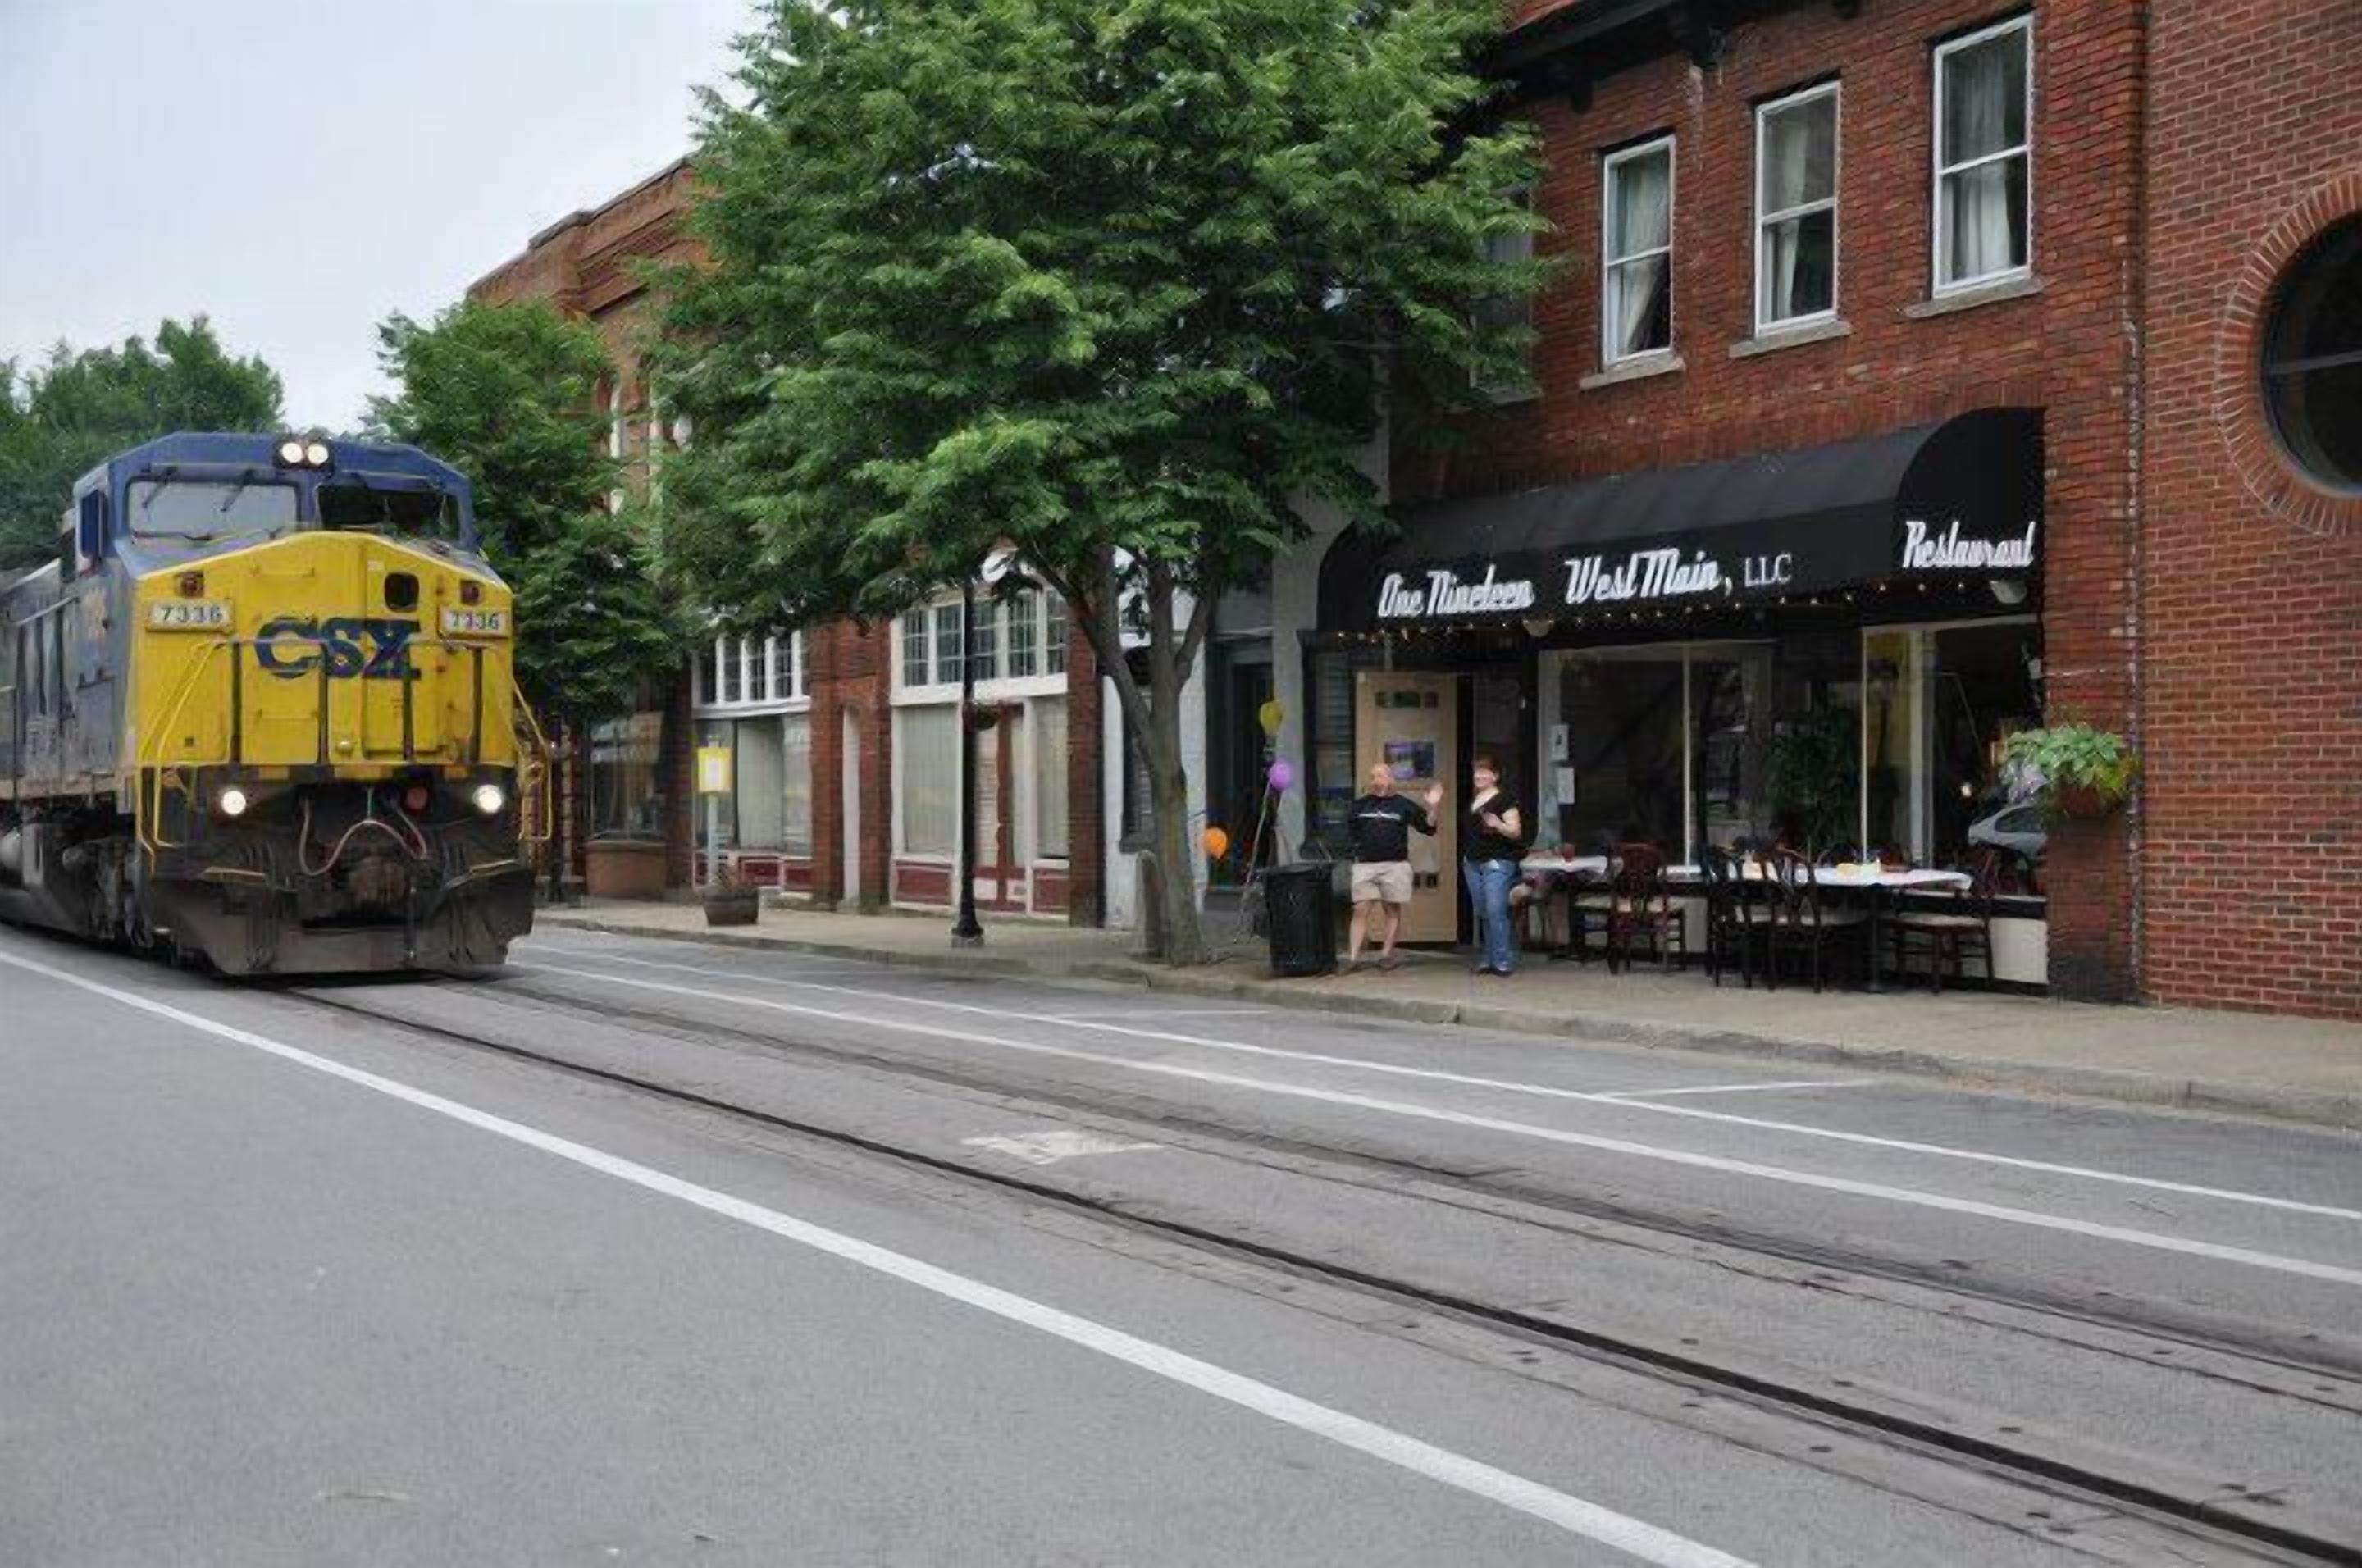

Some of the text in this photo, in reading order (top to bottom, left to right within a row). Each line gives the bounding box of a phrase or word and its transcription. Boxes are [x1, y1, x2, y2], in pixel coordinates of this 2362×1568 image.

[1902, 520, 2036, 568] Restaurant
[1378, 572, 1423, 617] One
[1427, 563, 1534, 615] Nineteen
[1565, 552, 1639, 604] West
[1744, 552, 1792, 587] LLC
[160, 605, 224, 624] 7336
[449, 610, 499, 631] 7336
[254, 616, 421, 679] CSX
